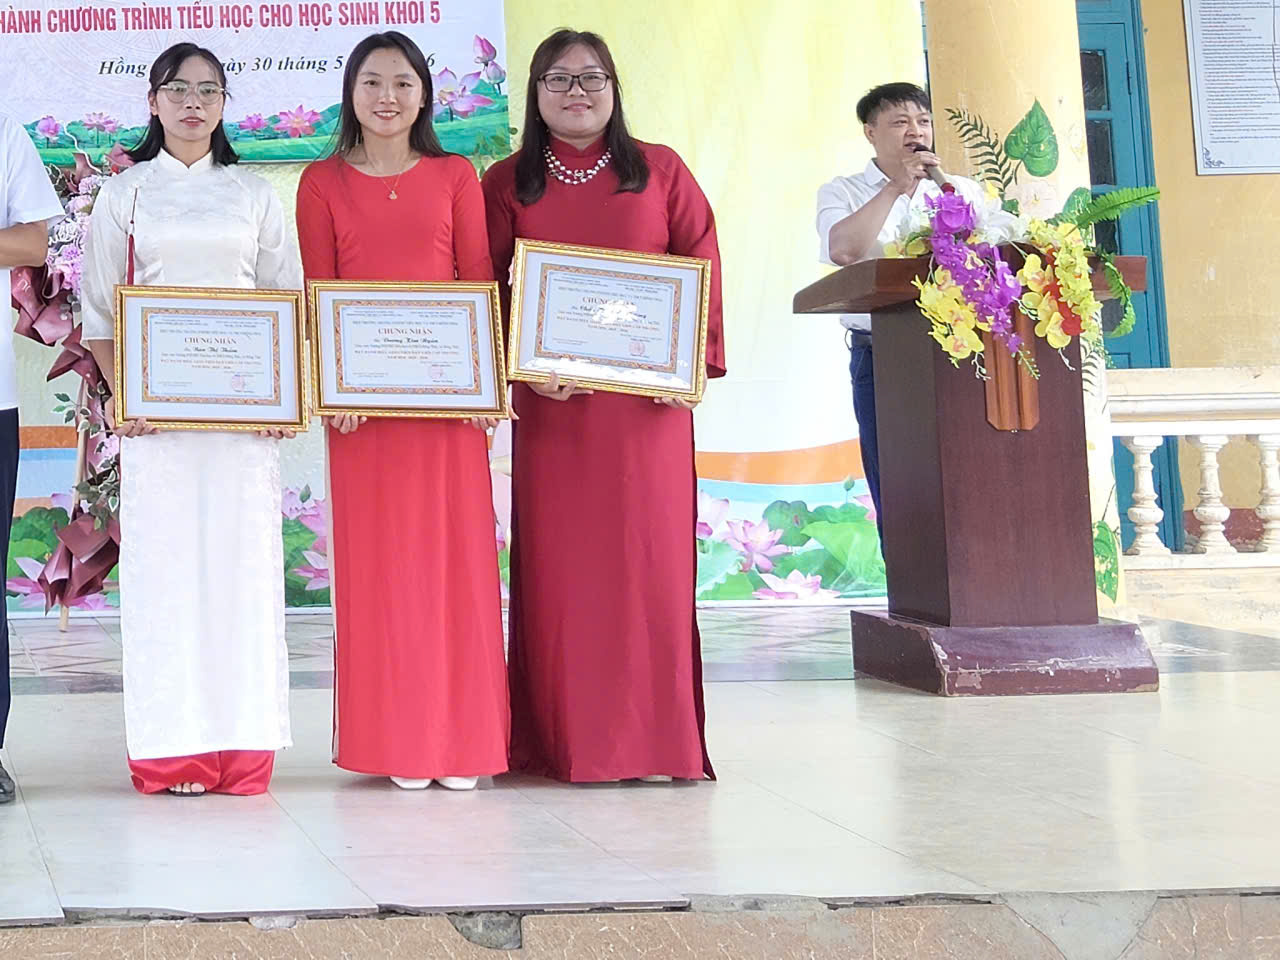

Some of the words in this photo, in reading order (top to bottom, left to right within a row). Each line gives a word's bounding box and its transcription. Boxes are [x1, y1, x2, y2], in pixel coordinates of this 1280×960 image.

[47, 6, 117, 33] CHƯƠNG
[122, 2, 172, 30] TRÌNH
[220, 4, 253, 33] HỌC
[259, 4, 293, 28] CHO
[298, 3, 332, 31] HỌC
[338, 2, 379, 25] SINH
[430, 0, 440, 23] 5
[98, 56, 147, 78] Hồng
[222, 57, 246, 75] ày
[251, 56, 272, 71] 30
[278, 56, 328, 73] tháng
[334, 55, 343, 70] 5
